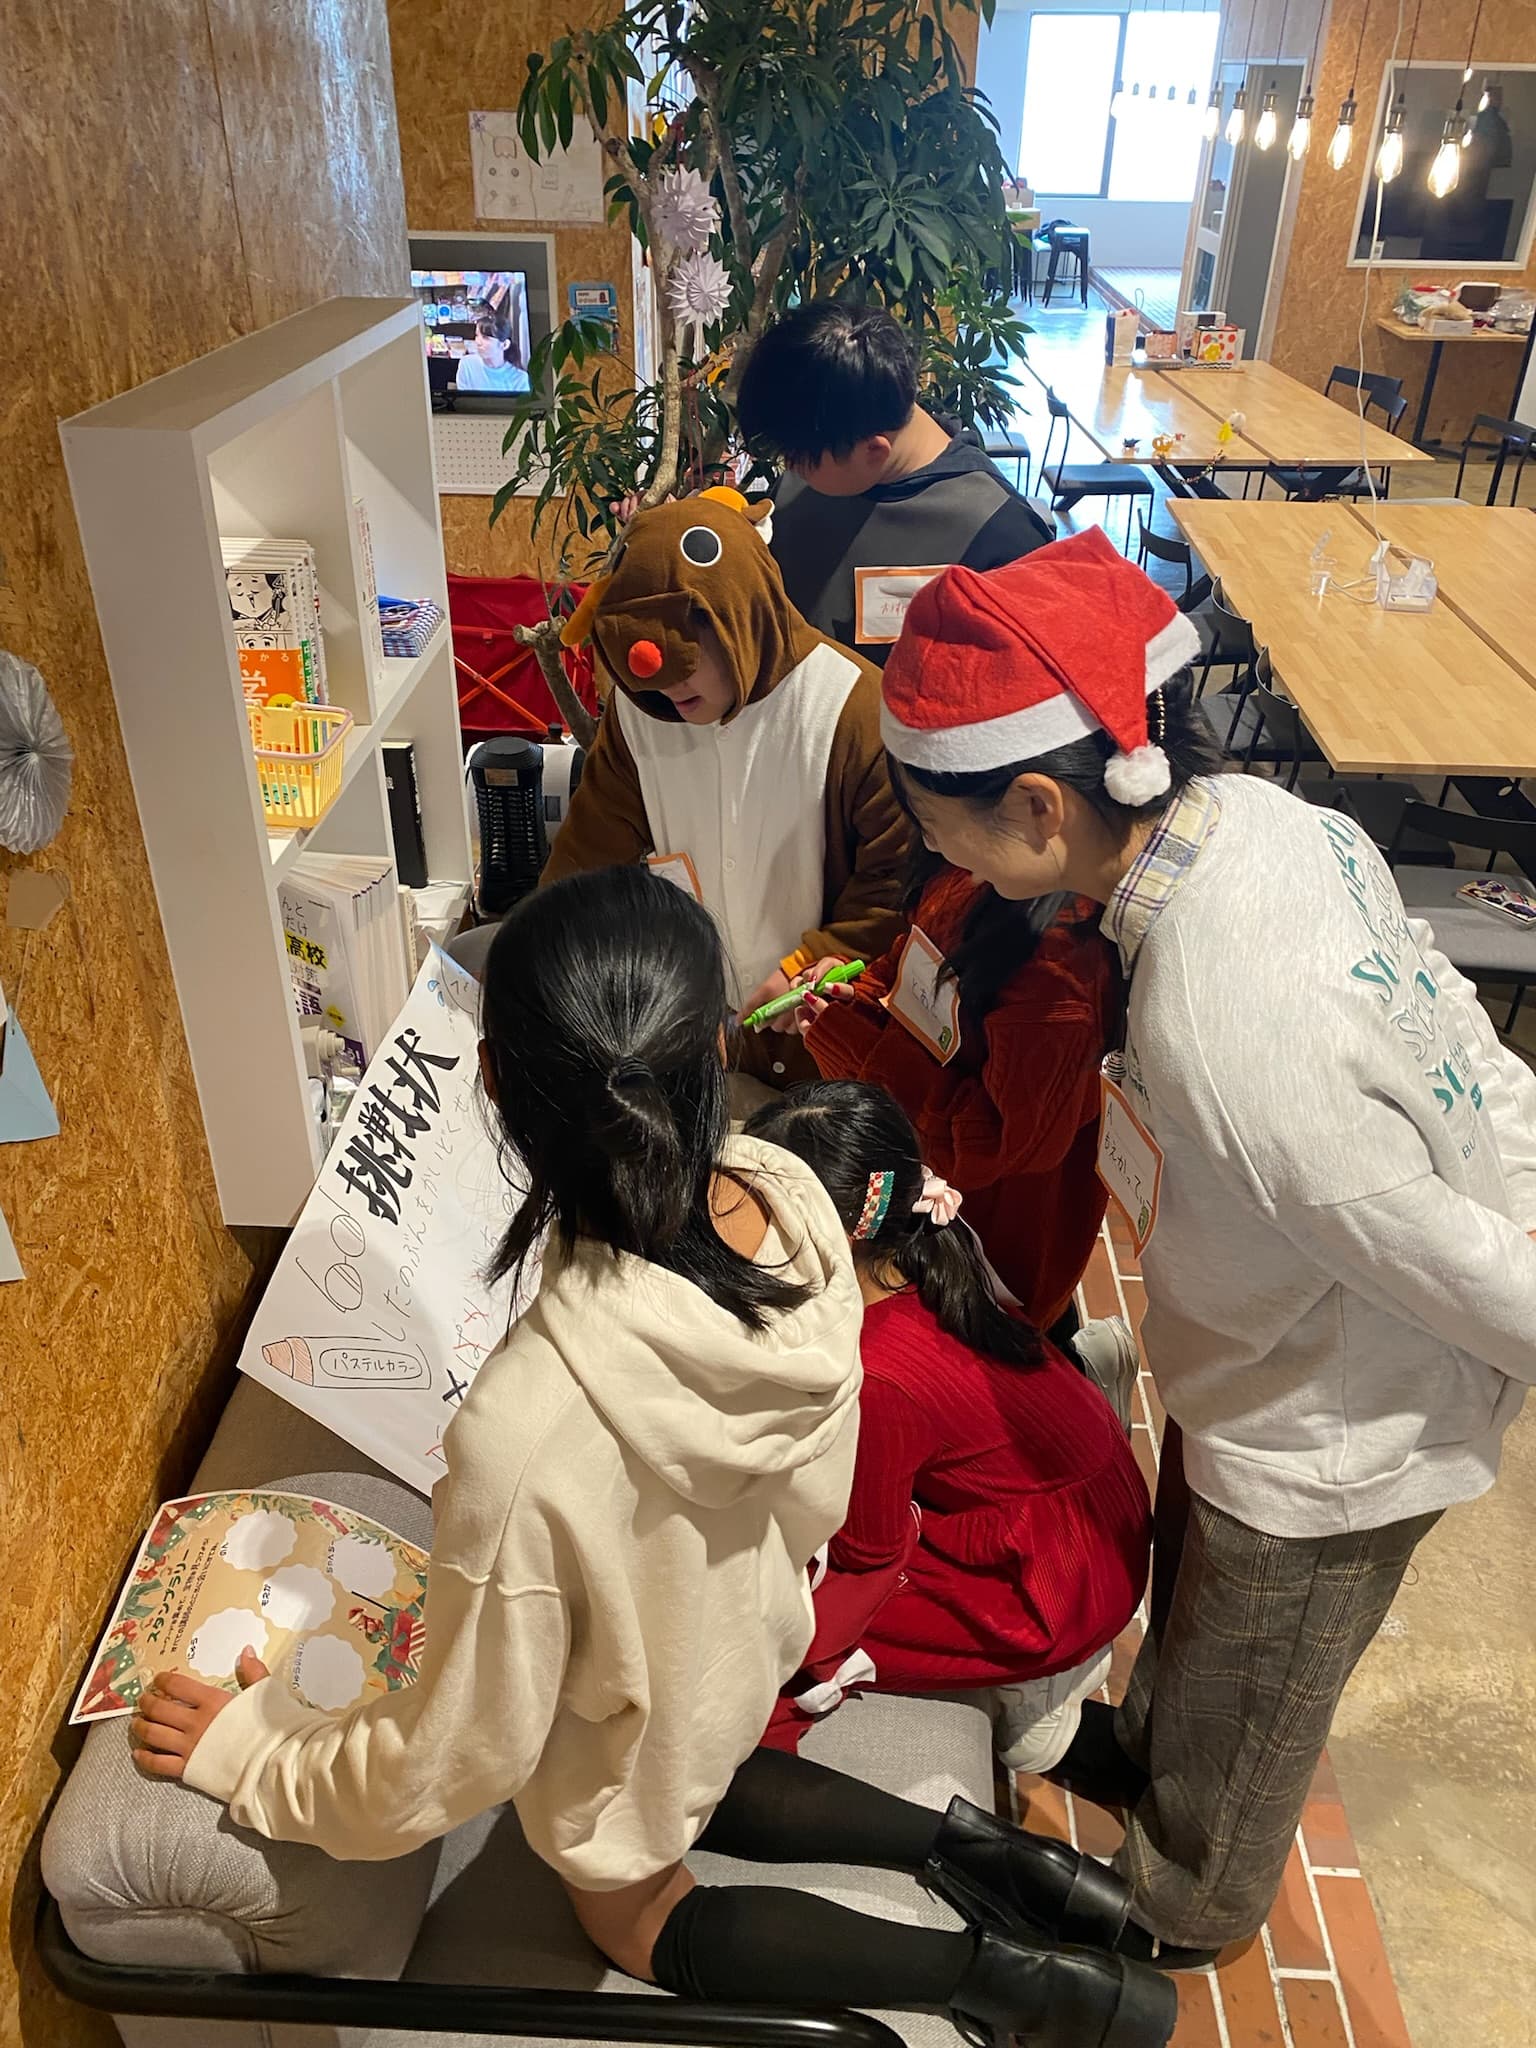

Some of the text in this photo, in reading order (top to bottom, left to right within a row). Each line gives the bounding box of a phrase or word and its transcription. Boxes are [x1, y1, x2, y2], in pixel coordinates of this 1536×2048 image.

[286, 933, 328, 969] 高校
[335, 1027, 461, 1226] 挑戦状
[333, 1351, 417, 1373] パステルカラー
[146, 1548, 190, 1643] スタンプラリー
